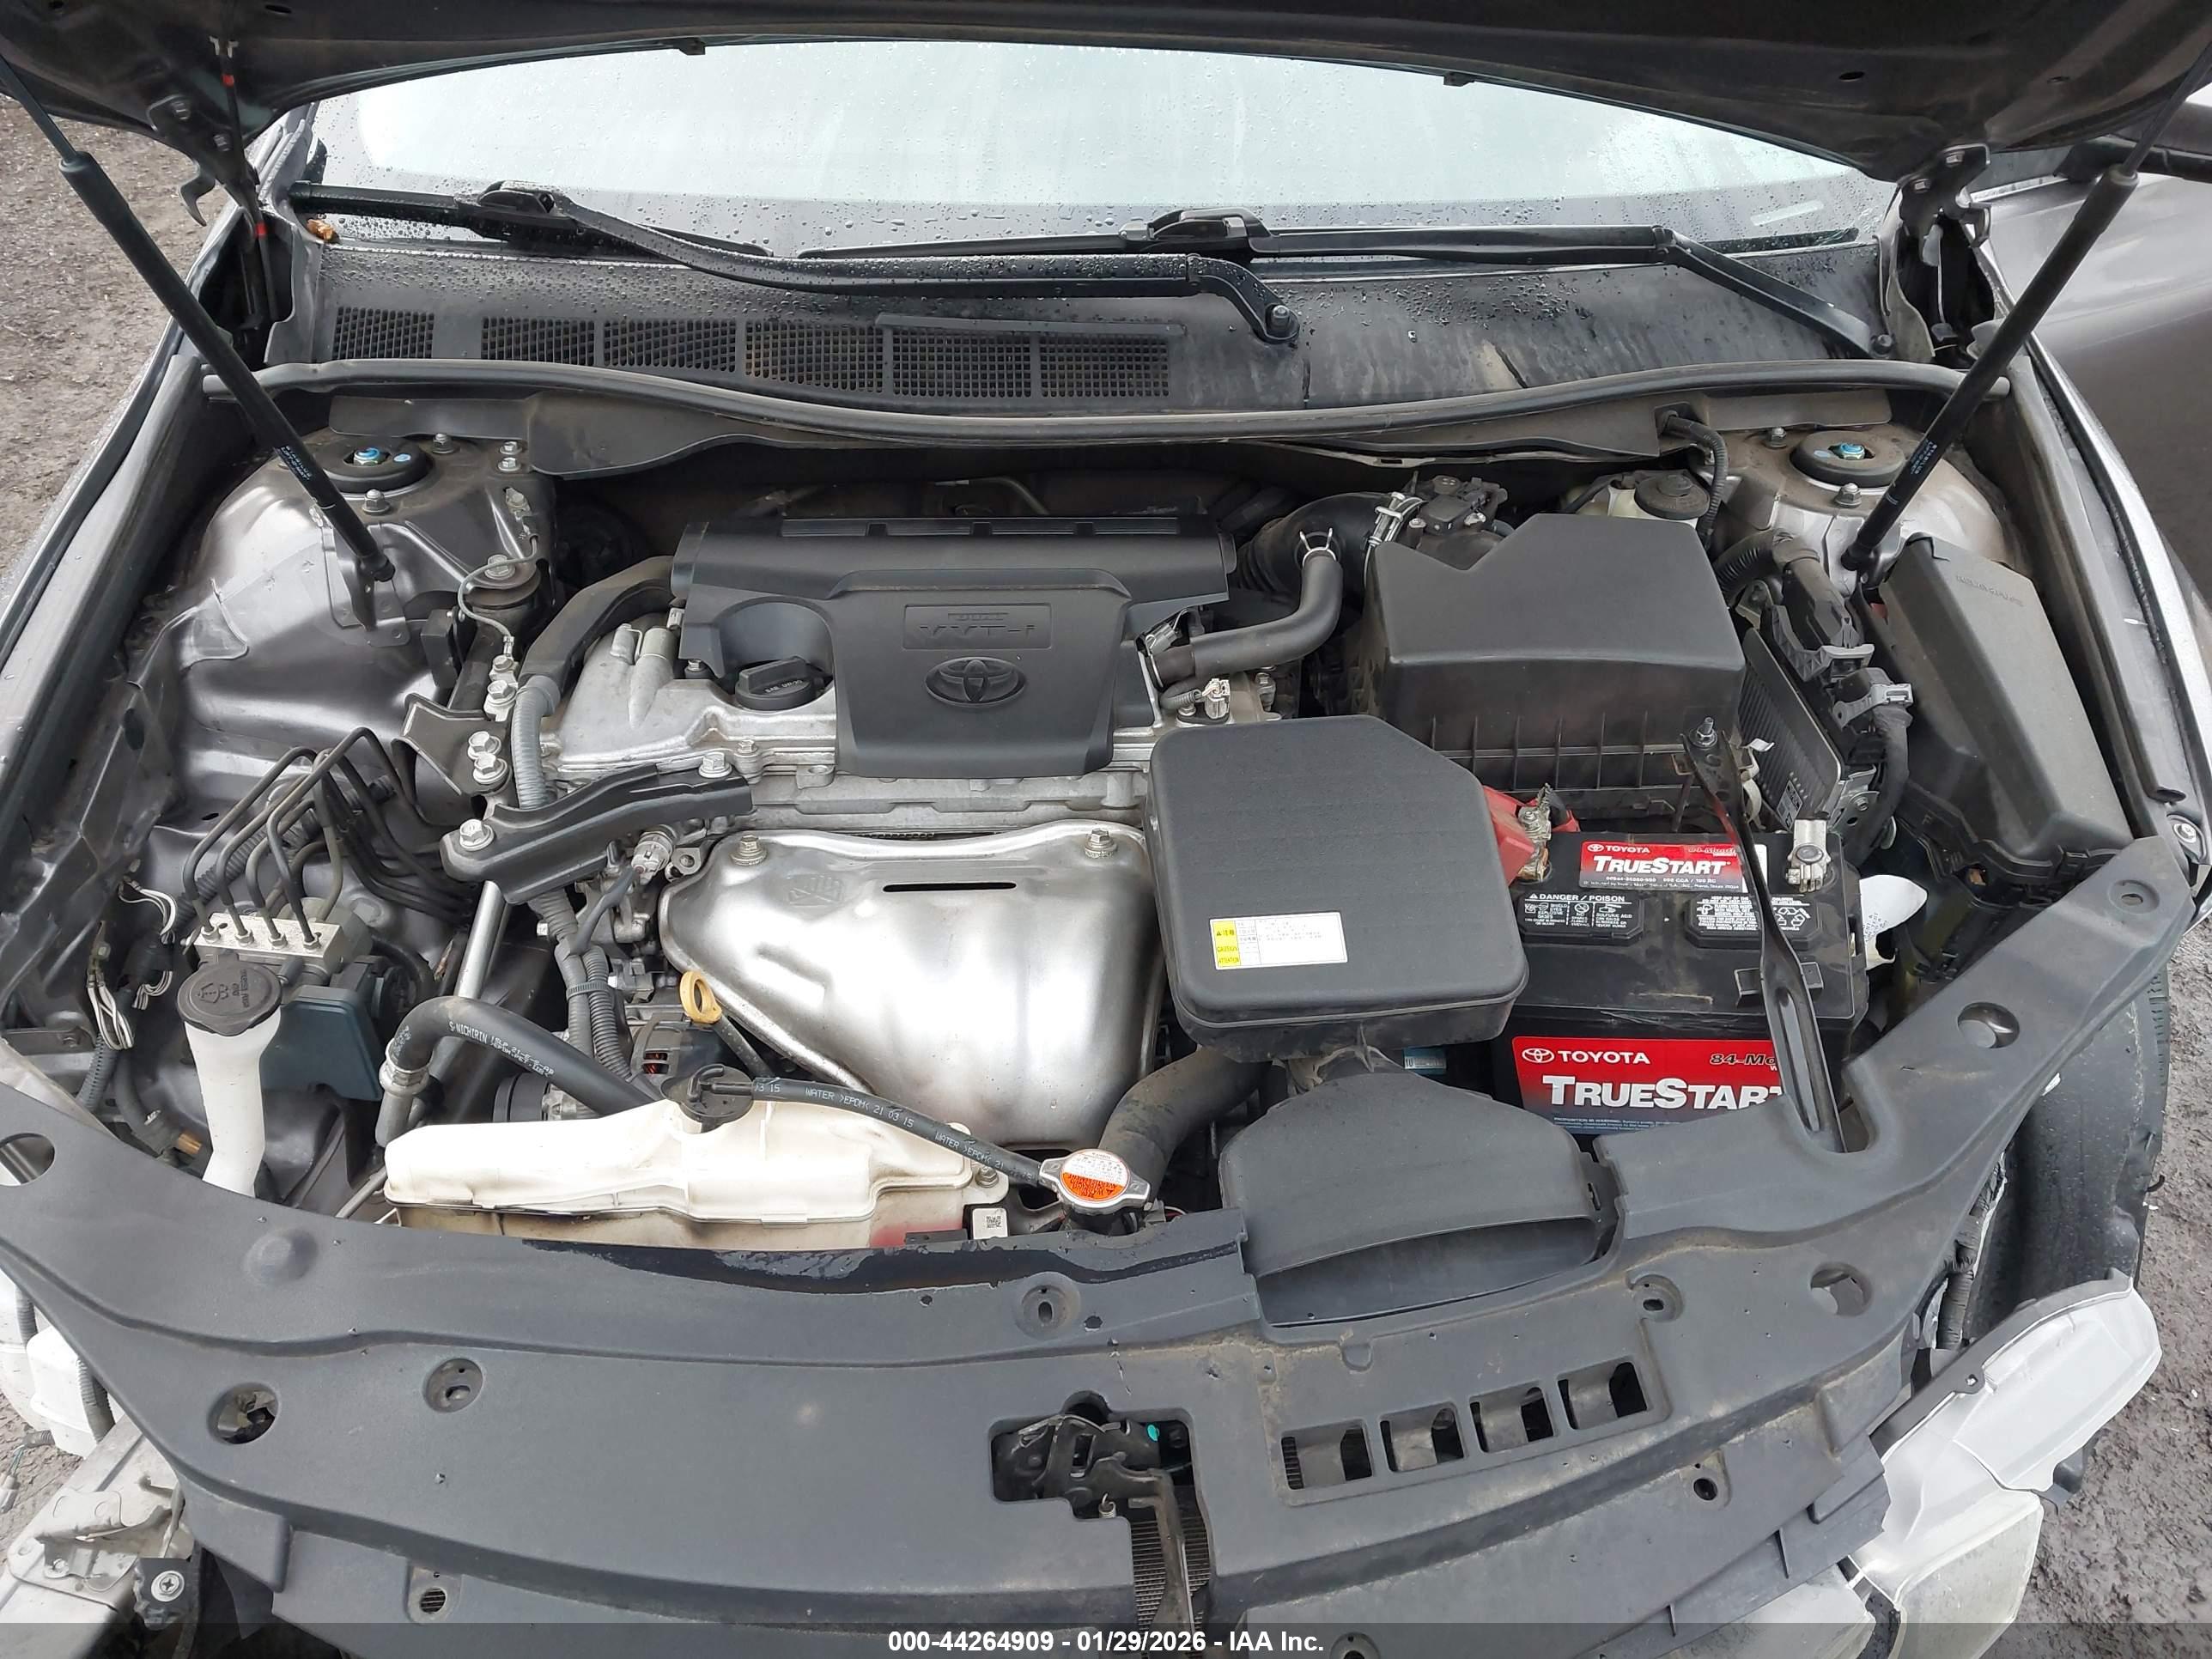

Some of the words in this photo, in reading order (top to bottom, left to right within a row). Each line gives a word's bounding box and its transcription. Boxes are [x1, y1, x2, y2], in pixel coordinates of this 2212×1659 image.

[1606, 845, 1650, 854] TOYOTA
[1557, 1050, 1651, 1065] TOYOTA
[1710, 1053, 1776, 1066] 84-Mo
[770, 1084, 781, 1092] 15
[805, 1087, 835, 1101] WATER
[873, 1105, 884, 1115] 21
[888, 1110, 900, 1121] 03
[902, 1116, 915, 1127] 15
[935, 1130, 960, 1150] WATER
